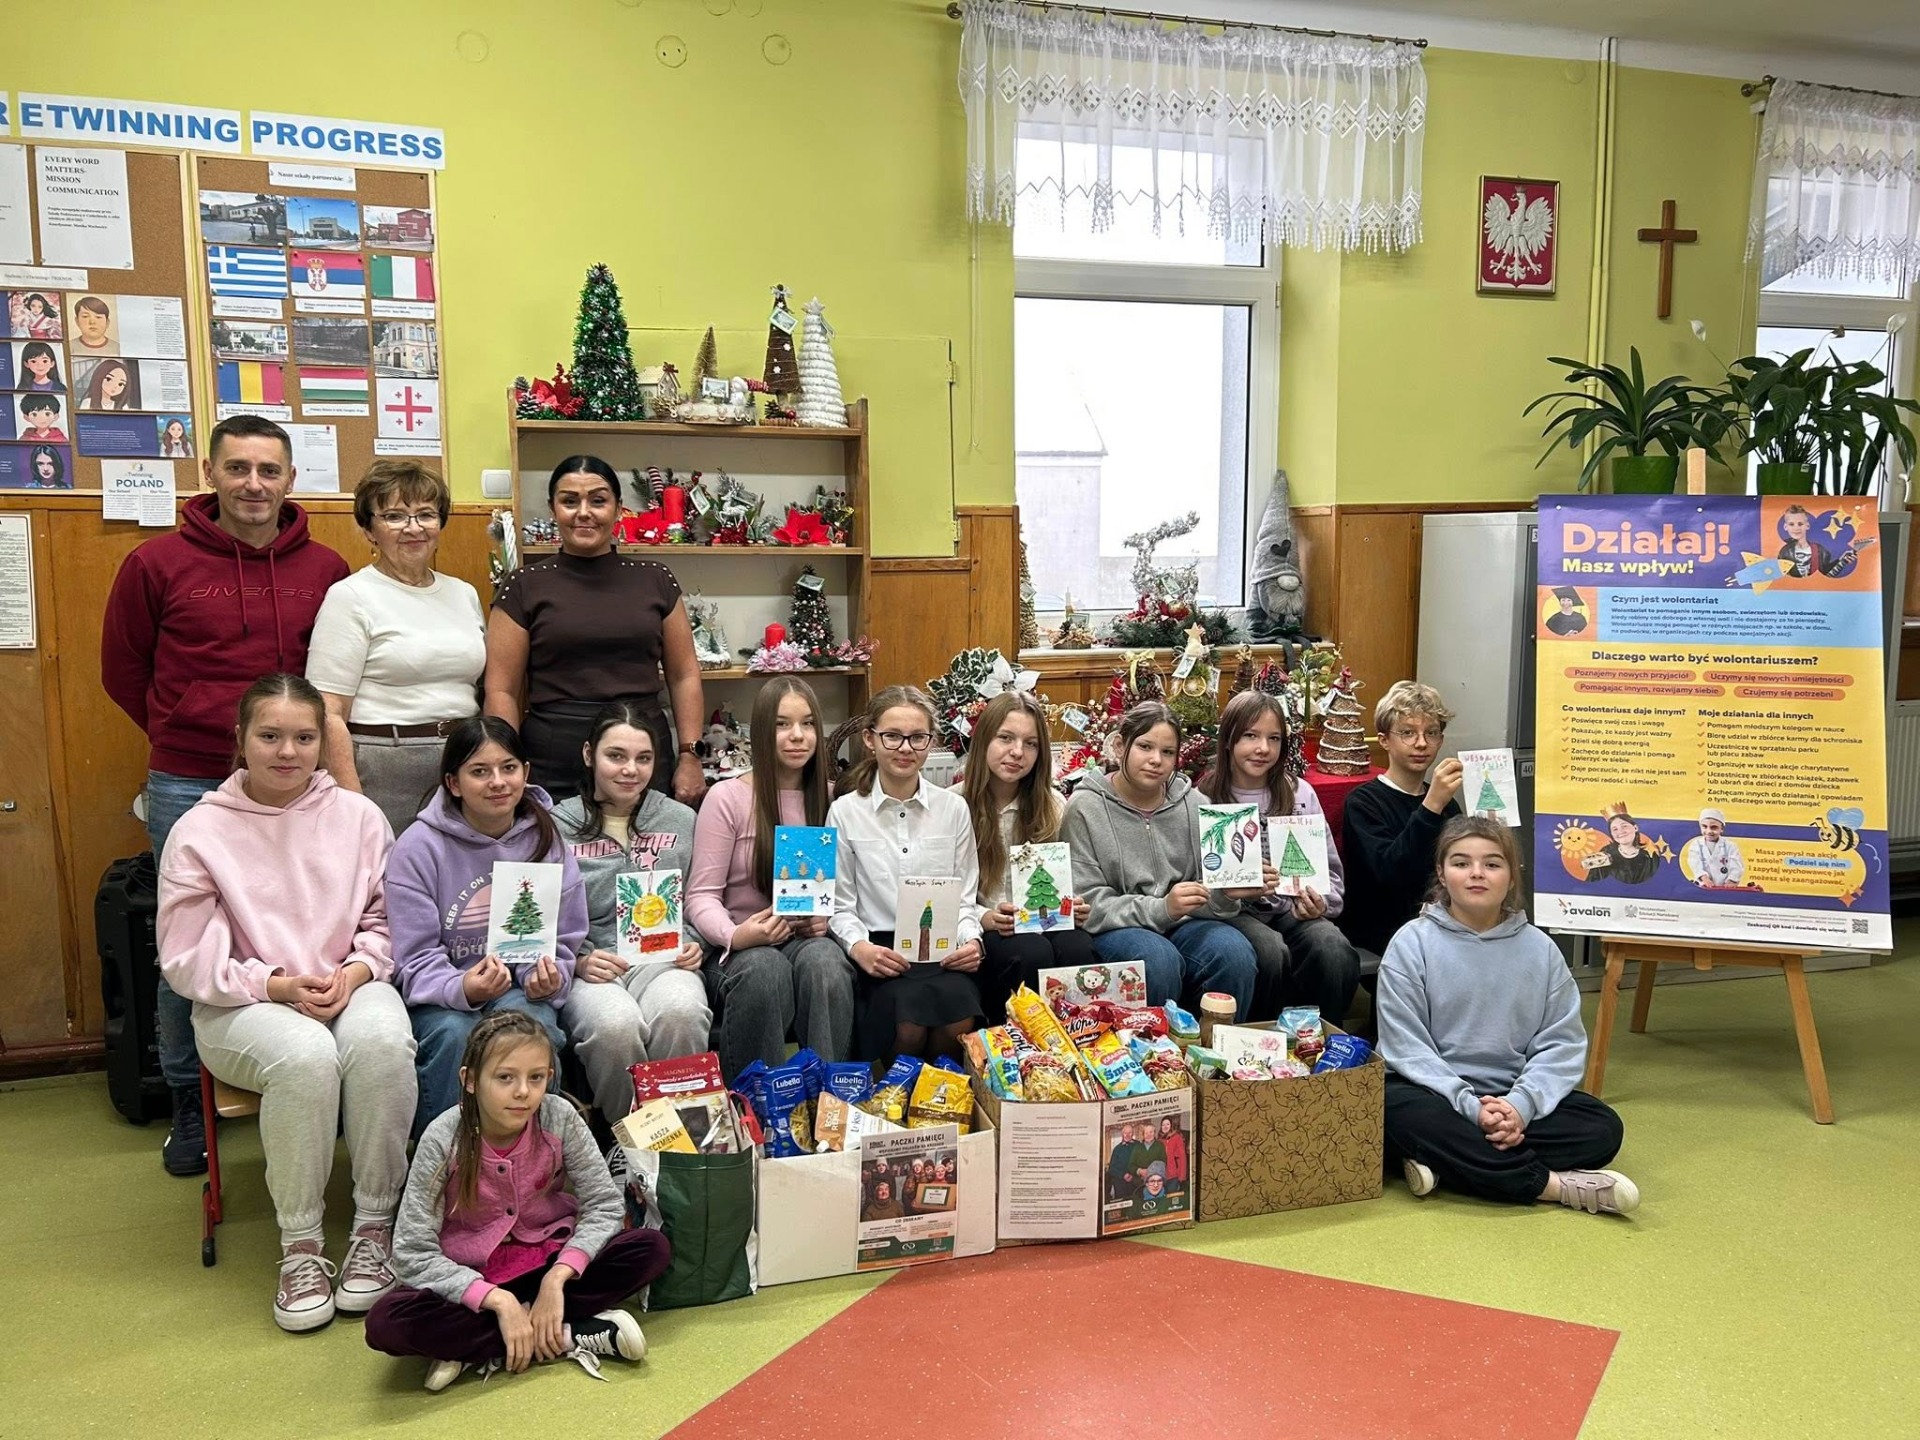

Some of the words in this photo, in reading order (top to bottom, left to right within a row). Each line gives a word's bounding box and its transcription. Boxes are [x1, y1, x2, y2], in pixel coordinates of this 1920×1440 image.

[21, 102, 239, 142] ETWINNING
[253, 120, 442, 160] PROGRESS
[46, 175, 81, 184] MISSION
[47, 186, 119, 196] COMMUNICATION
[116, 479, 164, 488] POLAND
[1563, 521, 1730, 563] Działaj!
[1563, 558, 1614, 573] Masz
[1620, 559, 1694, 577] wpływ!
[1611, 595, 1638, 605] Czym
[1640, 595, 1659, 605] jest
[1661, 595, 1718, 604] wolontariat
[1592, 651, 1646, 663] Dlaczego
[1649, 653, 1684, 662] warto
[1688, 653, 1709, 664] być
[1712, 654, 1818, 665] wolontariuszem?
[1574, 669, 1616, 678] Poznajemy
[1618, 670, 1648, 679] nowych
[1710, 673, 1742, 682] Uczymy
[1744, 674, 1755, 682] się
[1792, 675, 1844, 684] umiejętności
[1652, 684, 1693, 694] rozwijamy
[1742, 688, 1778, 697] Czujemy
[1780, 689, 1792, 697] się
[1794, 690, 1833, 698] potrzebni
[1575, 705, 1631, 713] wolontariusz
[1633, 707, 1652, 715] daje
[1654, 707, 1686, 716] innym?
[1698, 709, 1720, 718] Moje
[1782, 711, 1813, 720] innych
[1706, 760, 1746, 768] Organizuję
[444, 904, 459, 930] KEEP
[458, 890, 468, 900] IT
[470, 876, 484, 889] ON
[1570, 906, 1611, 917] avalon
[1332, 1041, 1350, 1054] bella
[776, 1077, 801, 1089] Lubella
[835, 1076, 863, 1085] Lubella
[1131, 1100, 1153, 1109] PACZKI
[1154, 1095, 1179, 1105] PAMIĘCI
[650, 1127, 670, 1141] KASZA
[891, 1138, 914, 1146] PACZKI
[917, 1134, 944, 1143] PAMIĘCI
